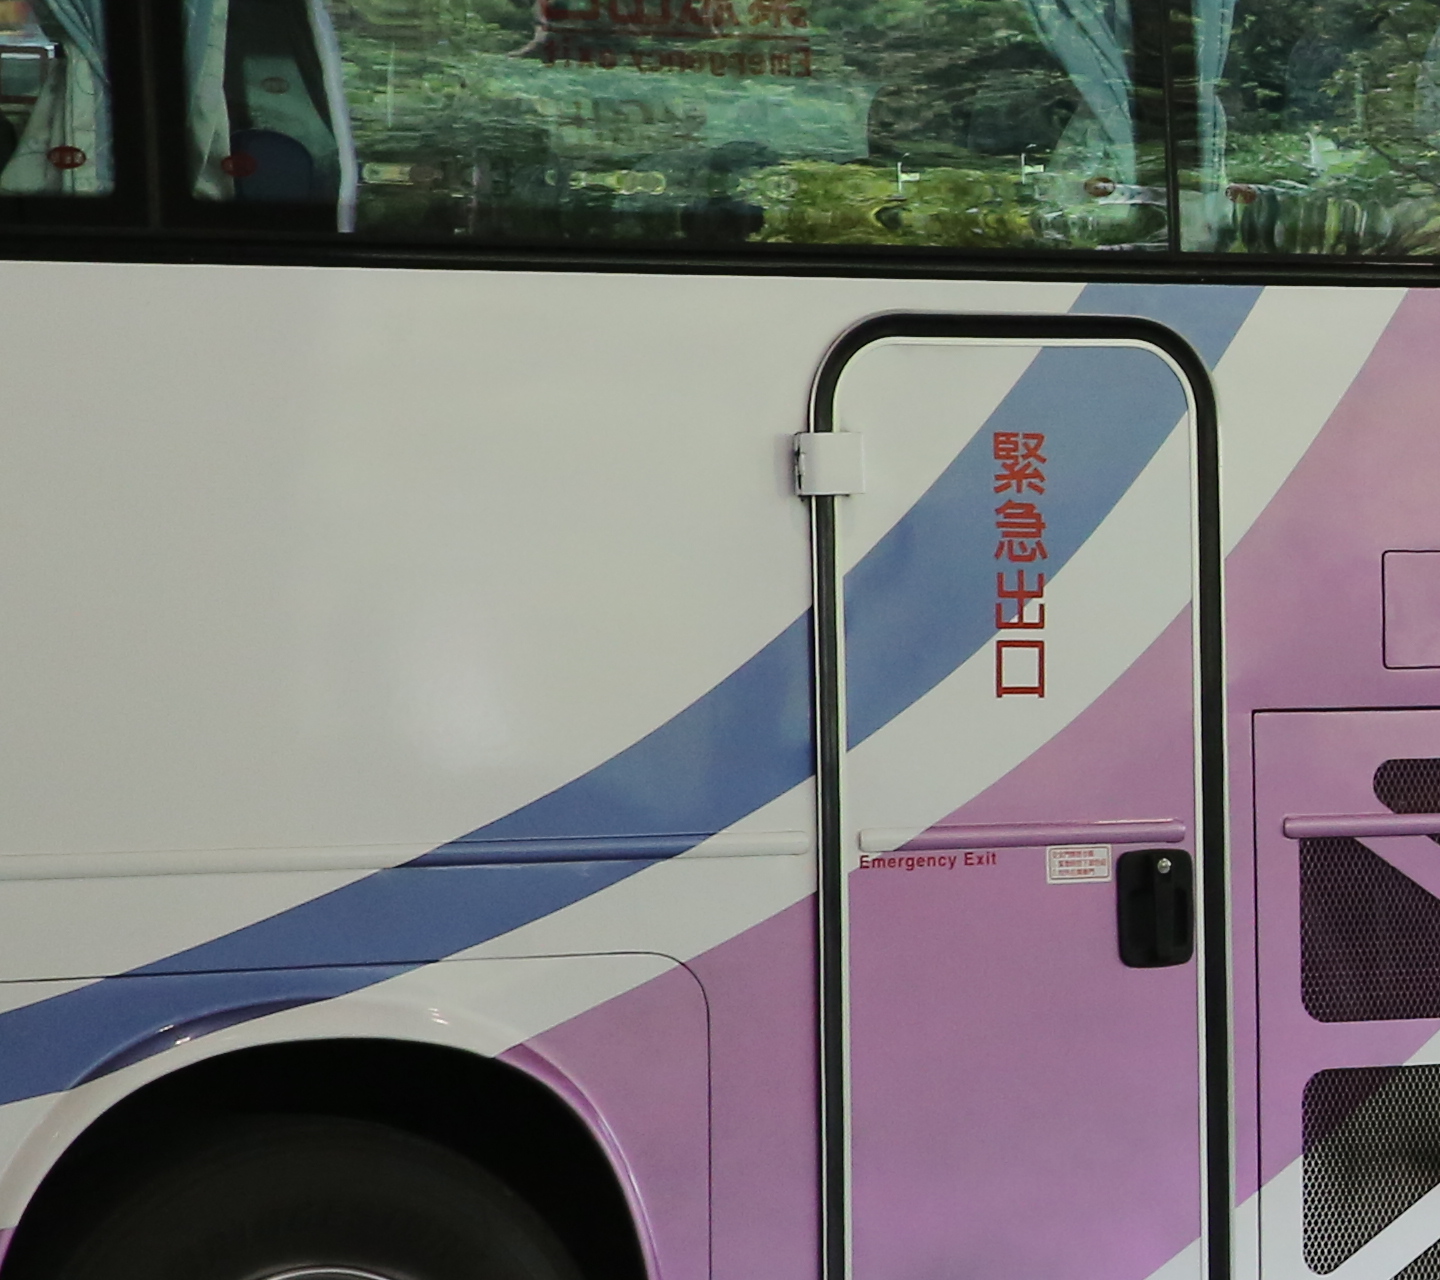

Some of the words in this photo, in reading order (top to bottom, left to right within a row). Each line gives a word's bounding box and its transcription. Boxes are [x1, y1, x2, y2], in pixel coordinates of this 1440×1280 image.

[994, 431, 1047, 699] 緊急出口
[859, 854, 957, 871] Emergency
[964, 851, 997, 866] Exit
